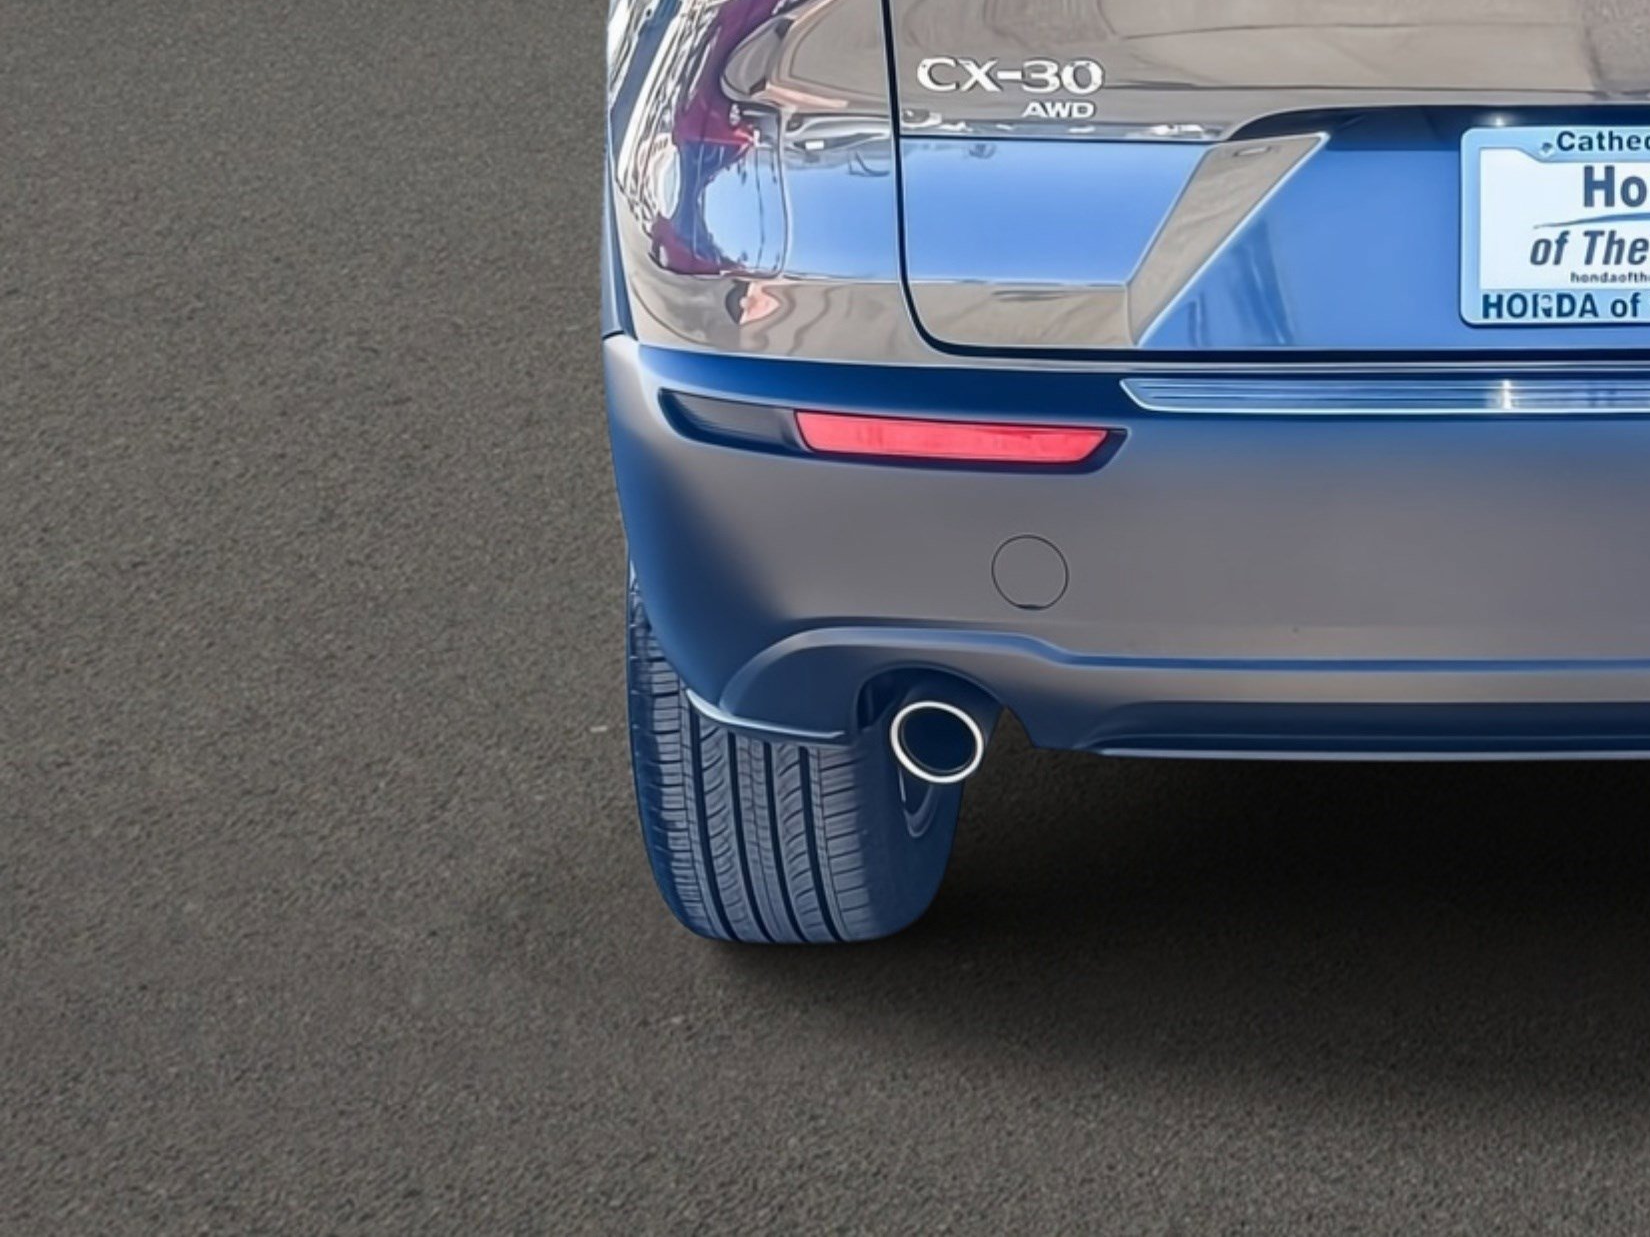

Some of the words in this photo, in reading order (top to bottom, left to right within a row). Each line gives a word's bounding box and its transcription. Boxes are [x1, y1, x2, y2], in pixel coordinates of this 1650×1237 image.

[916, 56, 1104, 95] CX-30
[1021, 100, 1096, 119] AWD
[1528, 229, 1570, 266] of
[1583, 229, 1650, 266] The
[1481, 292, 1600, 320] HONDA
[1609, 291, 1641, 319] of
